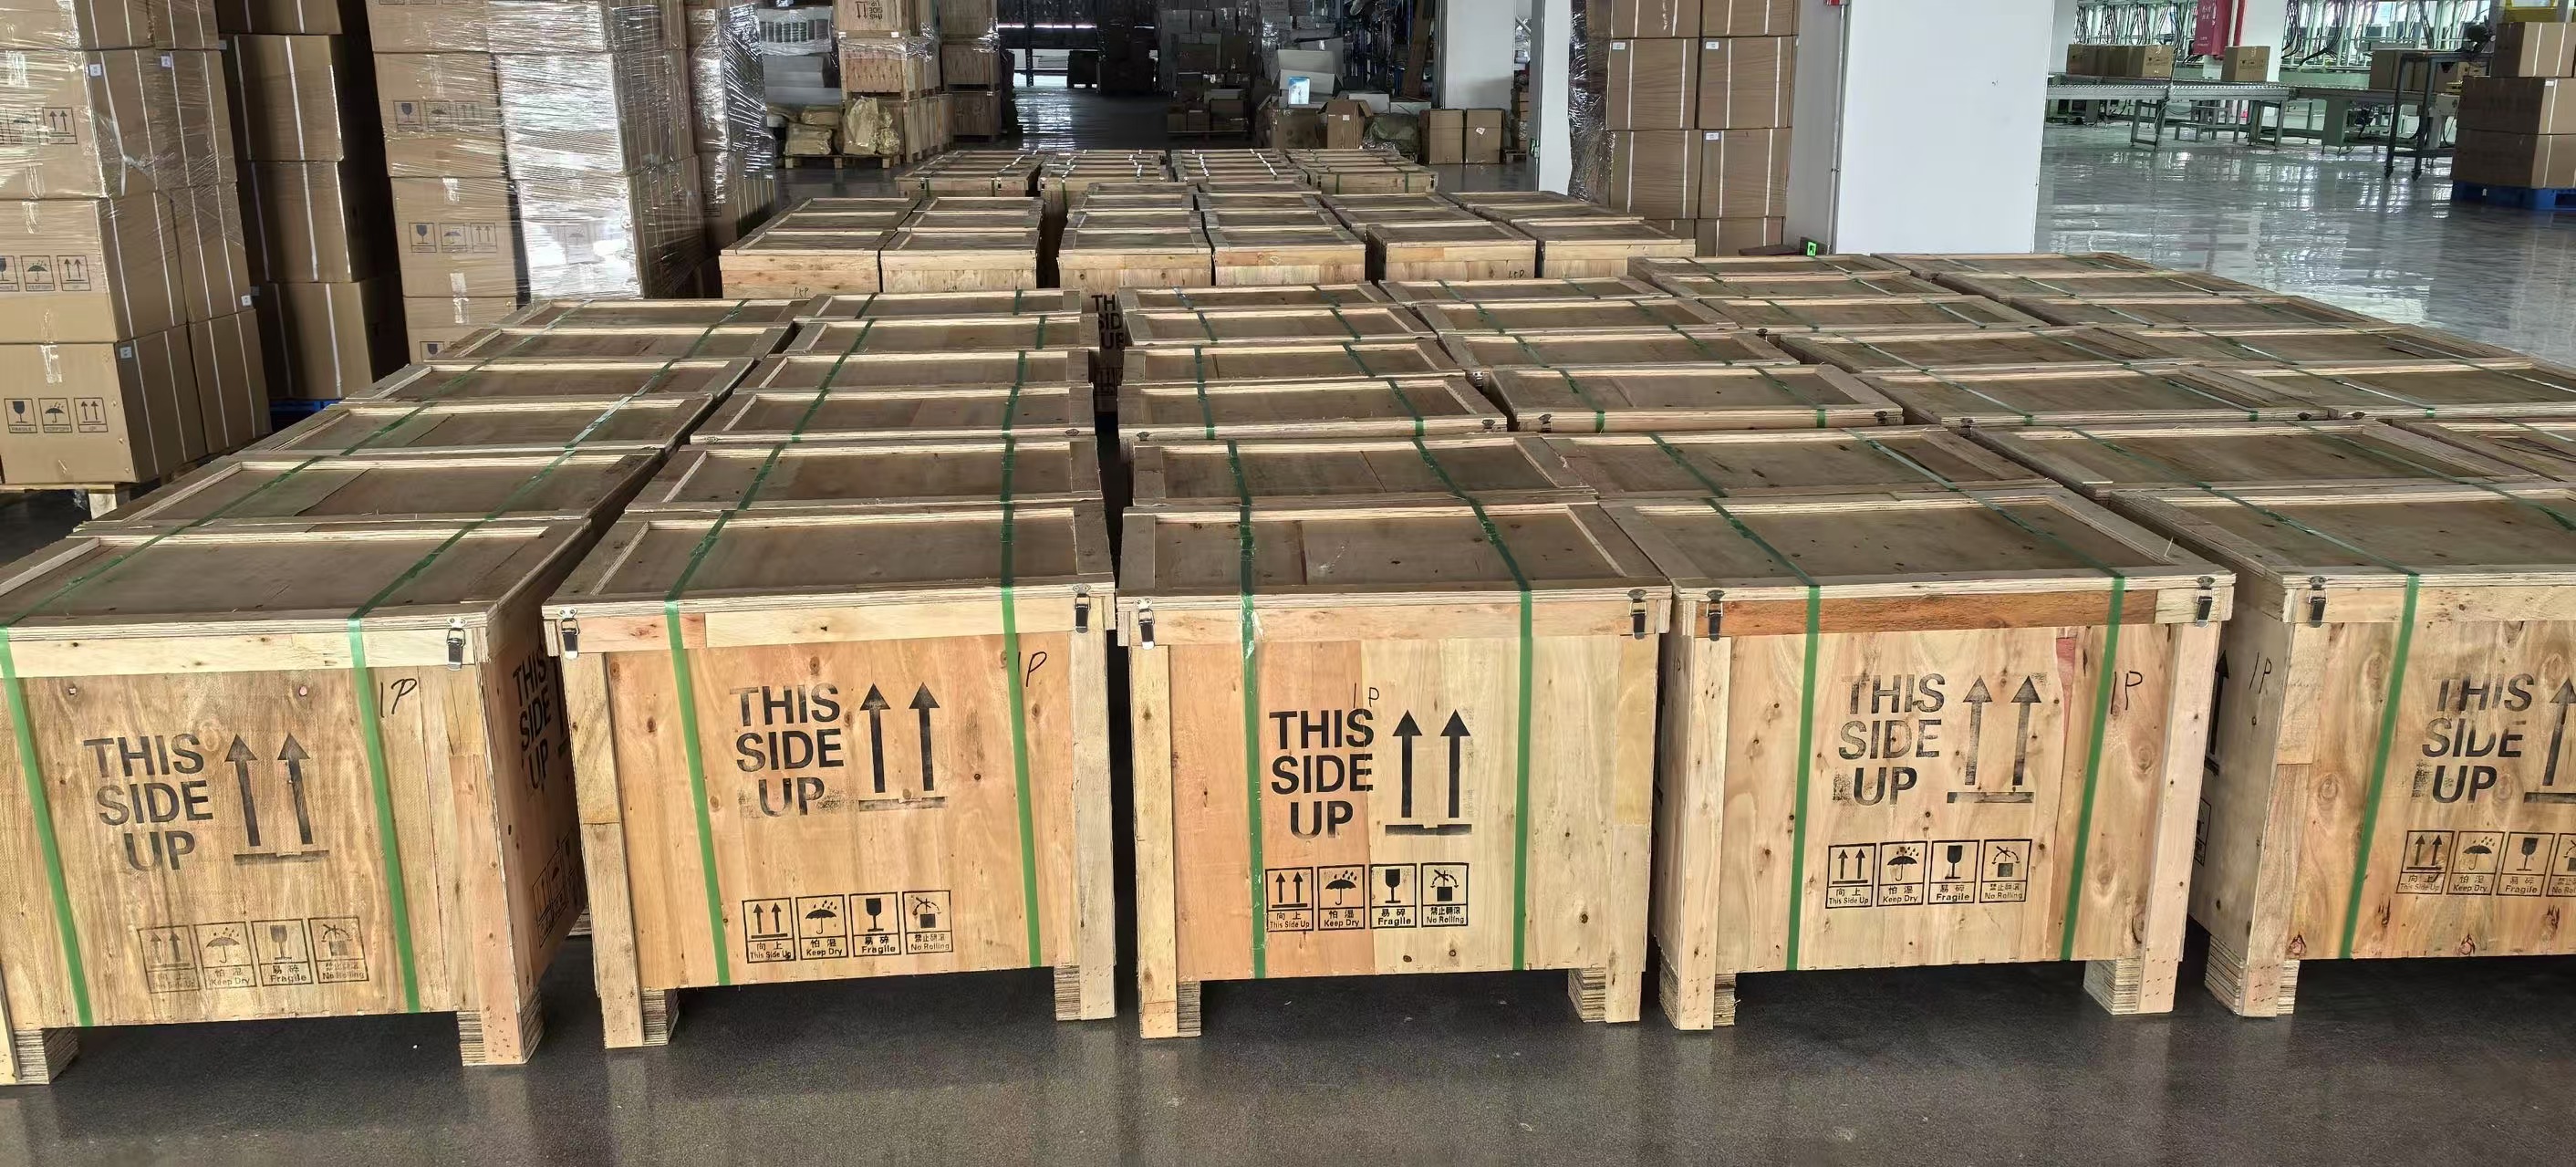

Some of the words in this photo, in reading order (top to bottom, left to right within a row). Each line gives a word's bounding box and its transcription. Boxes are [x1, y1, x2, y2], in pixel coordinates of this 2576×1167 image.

[1091, 294, 1116, 311] TH
[1098, 312, 1123, 329] SID
[730, 682, 842, 727] THIS
[1842, 672, 1947, 715] THIS
[2433, 672, 2535, 714] THIS
[520, 689, 552, 752] SIDE
[1269, 708, 1375, 750] THIS
[1838, 718, 1942, 760] SIDE
[2422, 717, 2527, 759] SIDE
[84, 733, 205, 778] THIS
[529, 738, 548, 789] UP
[736, 727, 846, 773] SIDE
[1271, 753, 1374, 796] SIDE
[1853, 766, 1917, 807] UP
[2432, 764, 2498, 804] UP
[97, 780, 214, 827] SIDE
[758, 776, 826, 818] UP
[1290, 800, 1355, 839] UP
[124, 829, 196, 871] UP
[1829, 897, 1842, 905] This
[1844, 896, 1858, 904] Side
[1859, 896, 1869, 905] Up
[1883, 896, 1902, 904] Keep
[1904, 894, 1918, 903] Dry
[1936, 893, 1970, 901] Fragile
[2453, 884, 2472, 892] Keep
[2474, 884, 2488, 892] Dry
[2505, 884, 2538, 893] Fragile
[1284, 920, 1298, 928] Side
[1300, 920, 1310, 928] Up
[1324, 919, 1344, 928] Keep
[1345, 918, 1359, 927] Dry
[1377, 916, 1411, 926] Fragile
[765, 950, 780, 958] Side
[781, 950, 792, 958] Up
[806, 948, 826, 957] Keep
[828, 947, 843, 956] Dry
[861, 945, 896, 955] Fragile
[270, 973, 307, 984] Fragile
